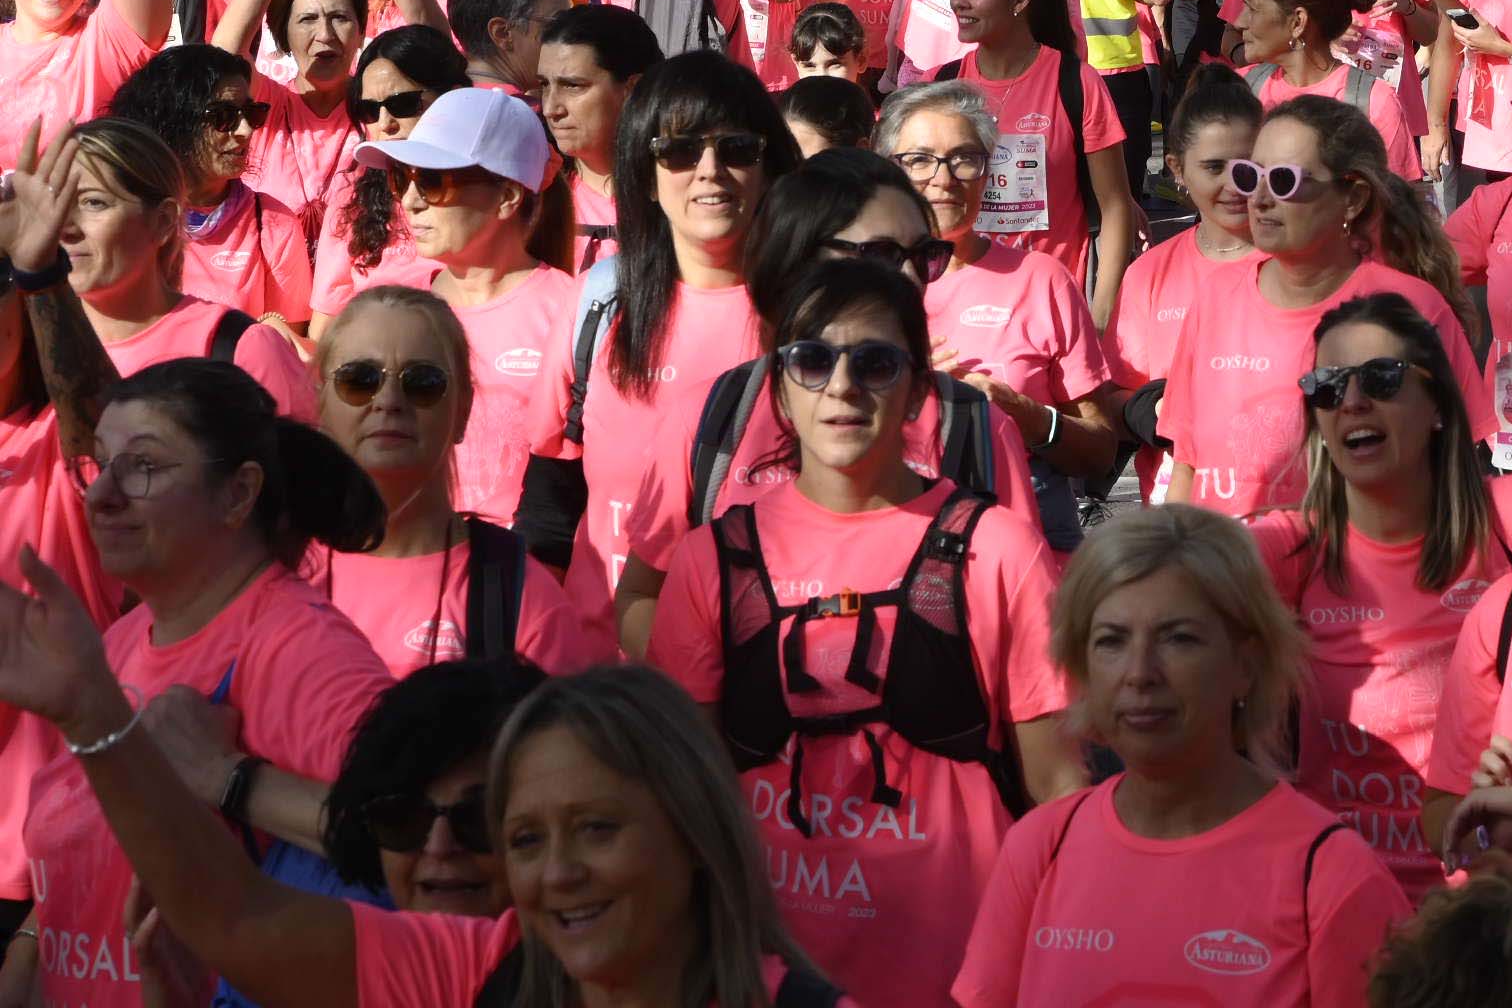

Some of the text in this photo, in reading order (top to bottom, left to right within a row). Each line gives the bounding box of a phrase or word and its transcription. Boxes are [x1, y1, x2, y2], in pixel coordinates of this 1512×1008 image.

[1210, 353, 1270, 372] OYSHO
[1195, 467, 1236, 499] TU
[1310, 606, 1385, 625] OYSHO
[1321, 719, 1369, 757] TU
[754, 779, 927, 841] DORSAL
[768, 848, 871, 902] UMA
[41, 930, 141, 982] ORSAL
[1035, 927, 1114, 953] OYSHO
[1189, 943, 1266, 966] ASTURIANA
